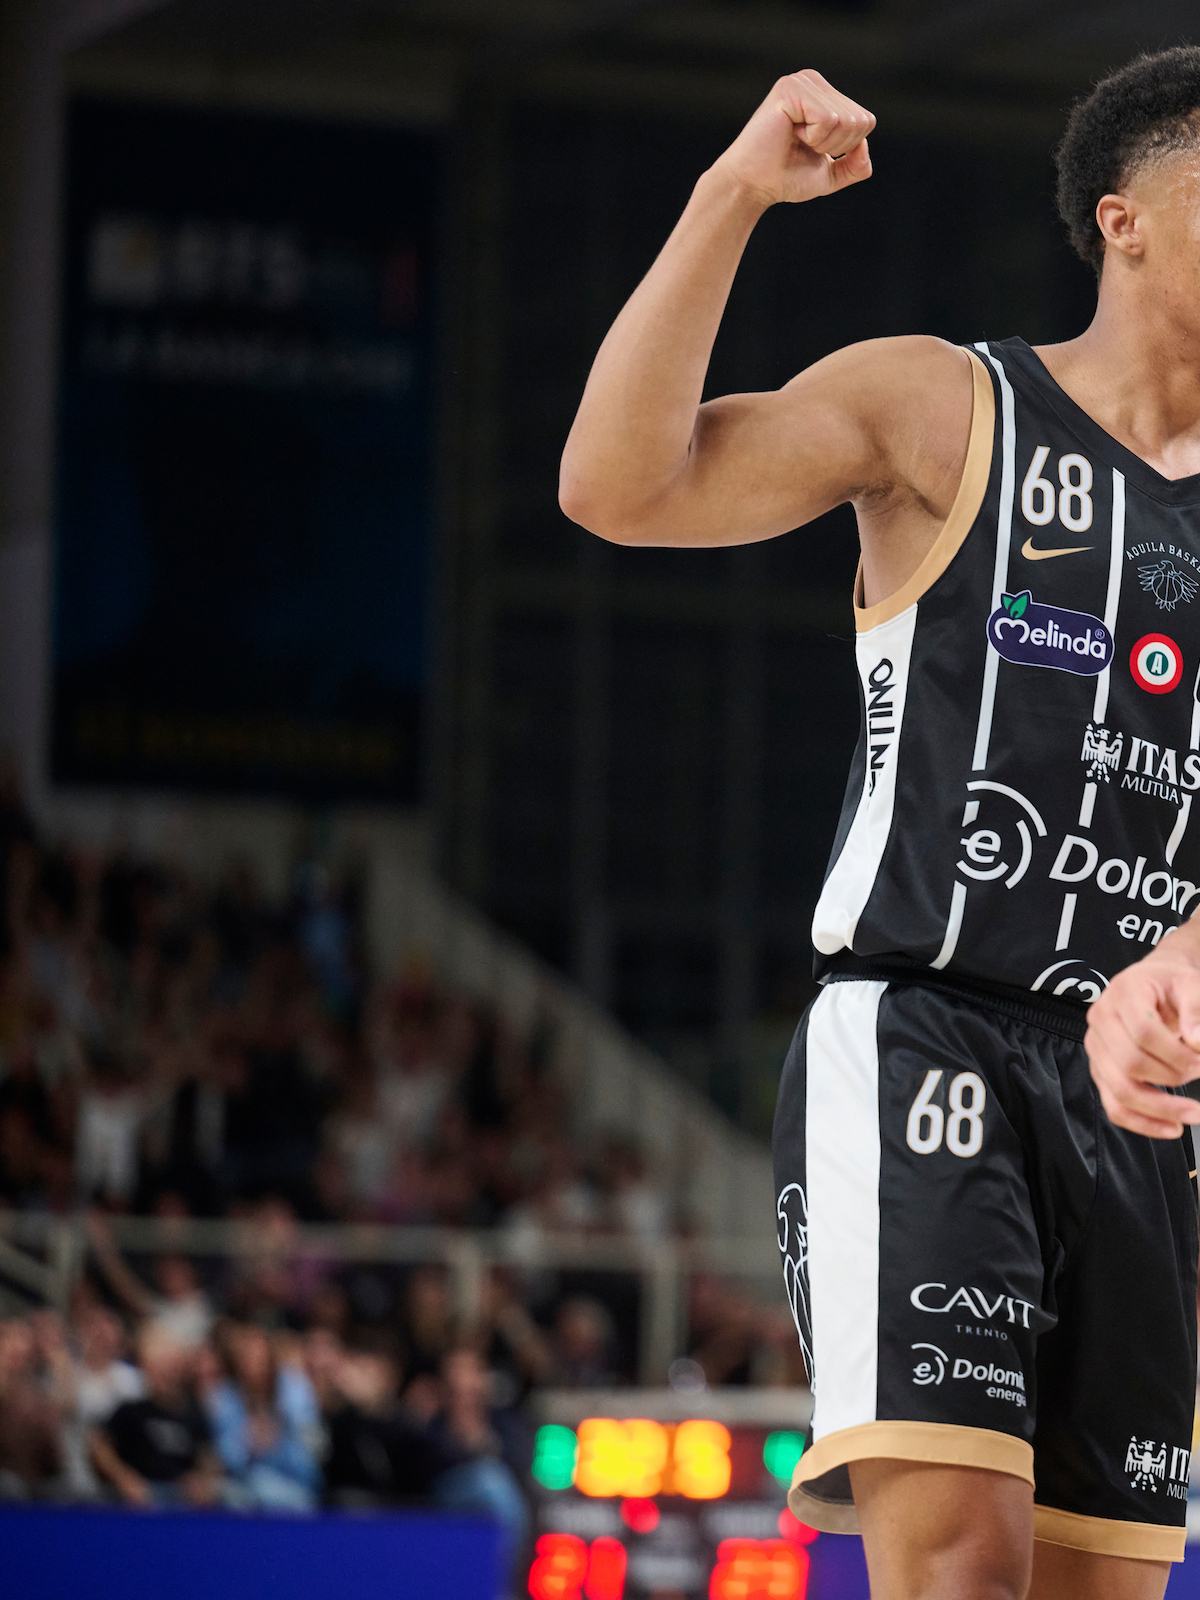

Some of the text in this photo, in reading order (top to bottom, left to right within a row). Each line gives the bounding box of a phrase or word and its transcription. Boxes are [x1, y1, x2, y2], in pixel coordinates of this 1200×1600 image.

[1022, 445, 1093, 532] 68
[1126, 542, 1166, 560] AQUILA
[994, 618, 1107, 660] Melinda
[1151, 652, 1165, 676] A
[1120, 773, 1179, 804] MUTUA
[906, 1070, 986, 1157] 68
[910, 1282, 1035, 1329] CAVIT
[955, 1324, 1008, 1341] TRENTO
